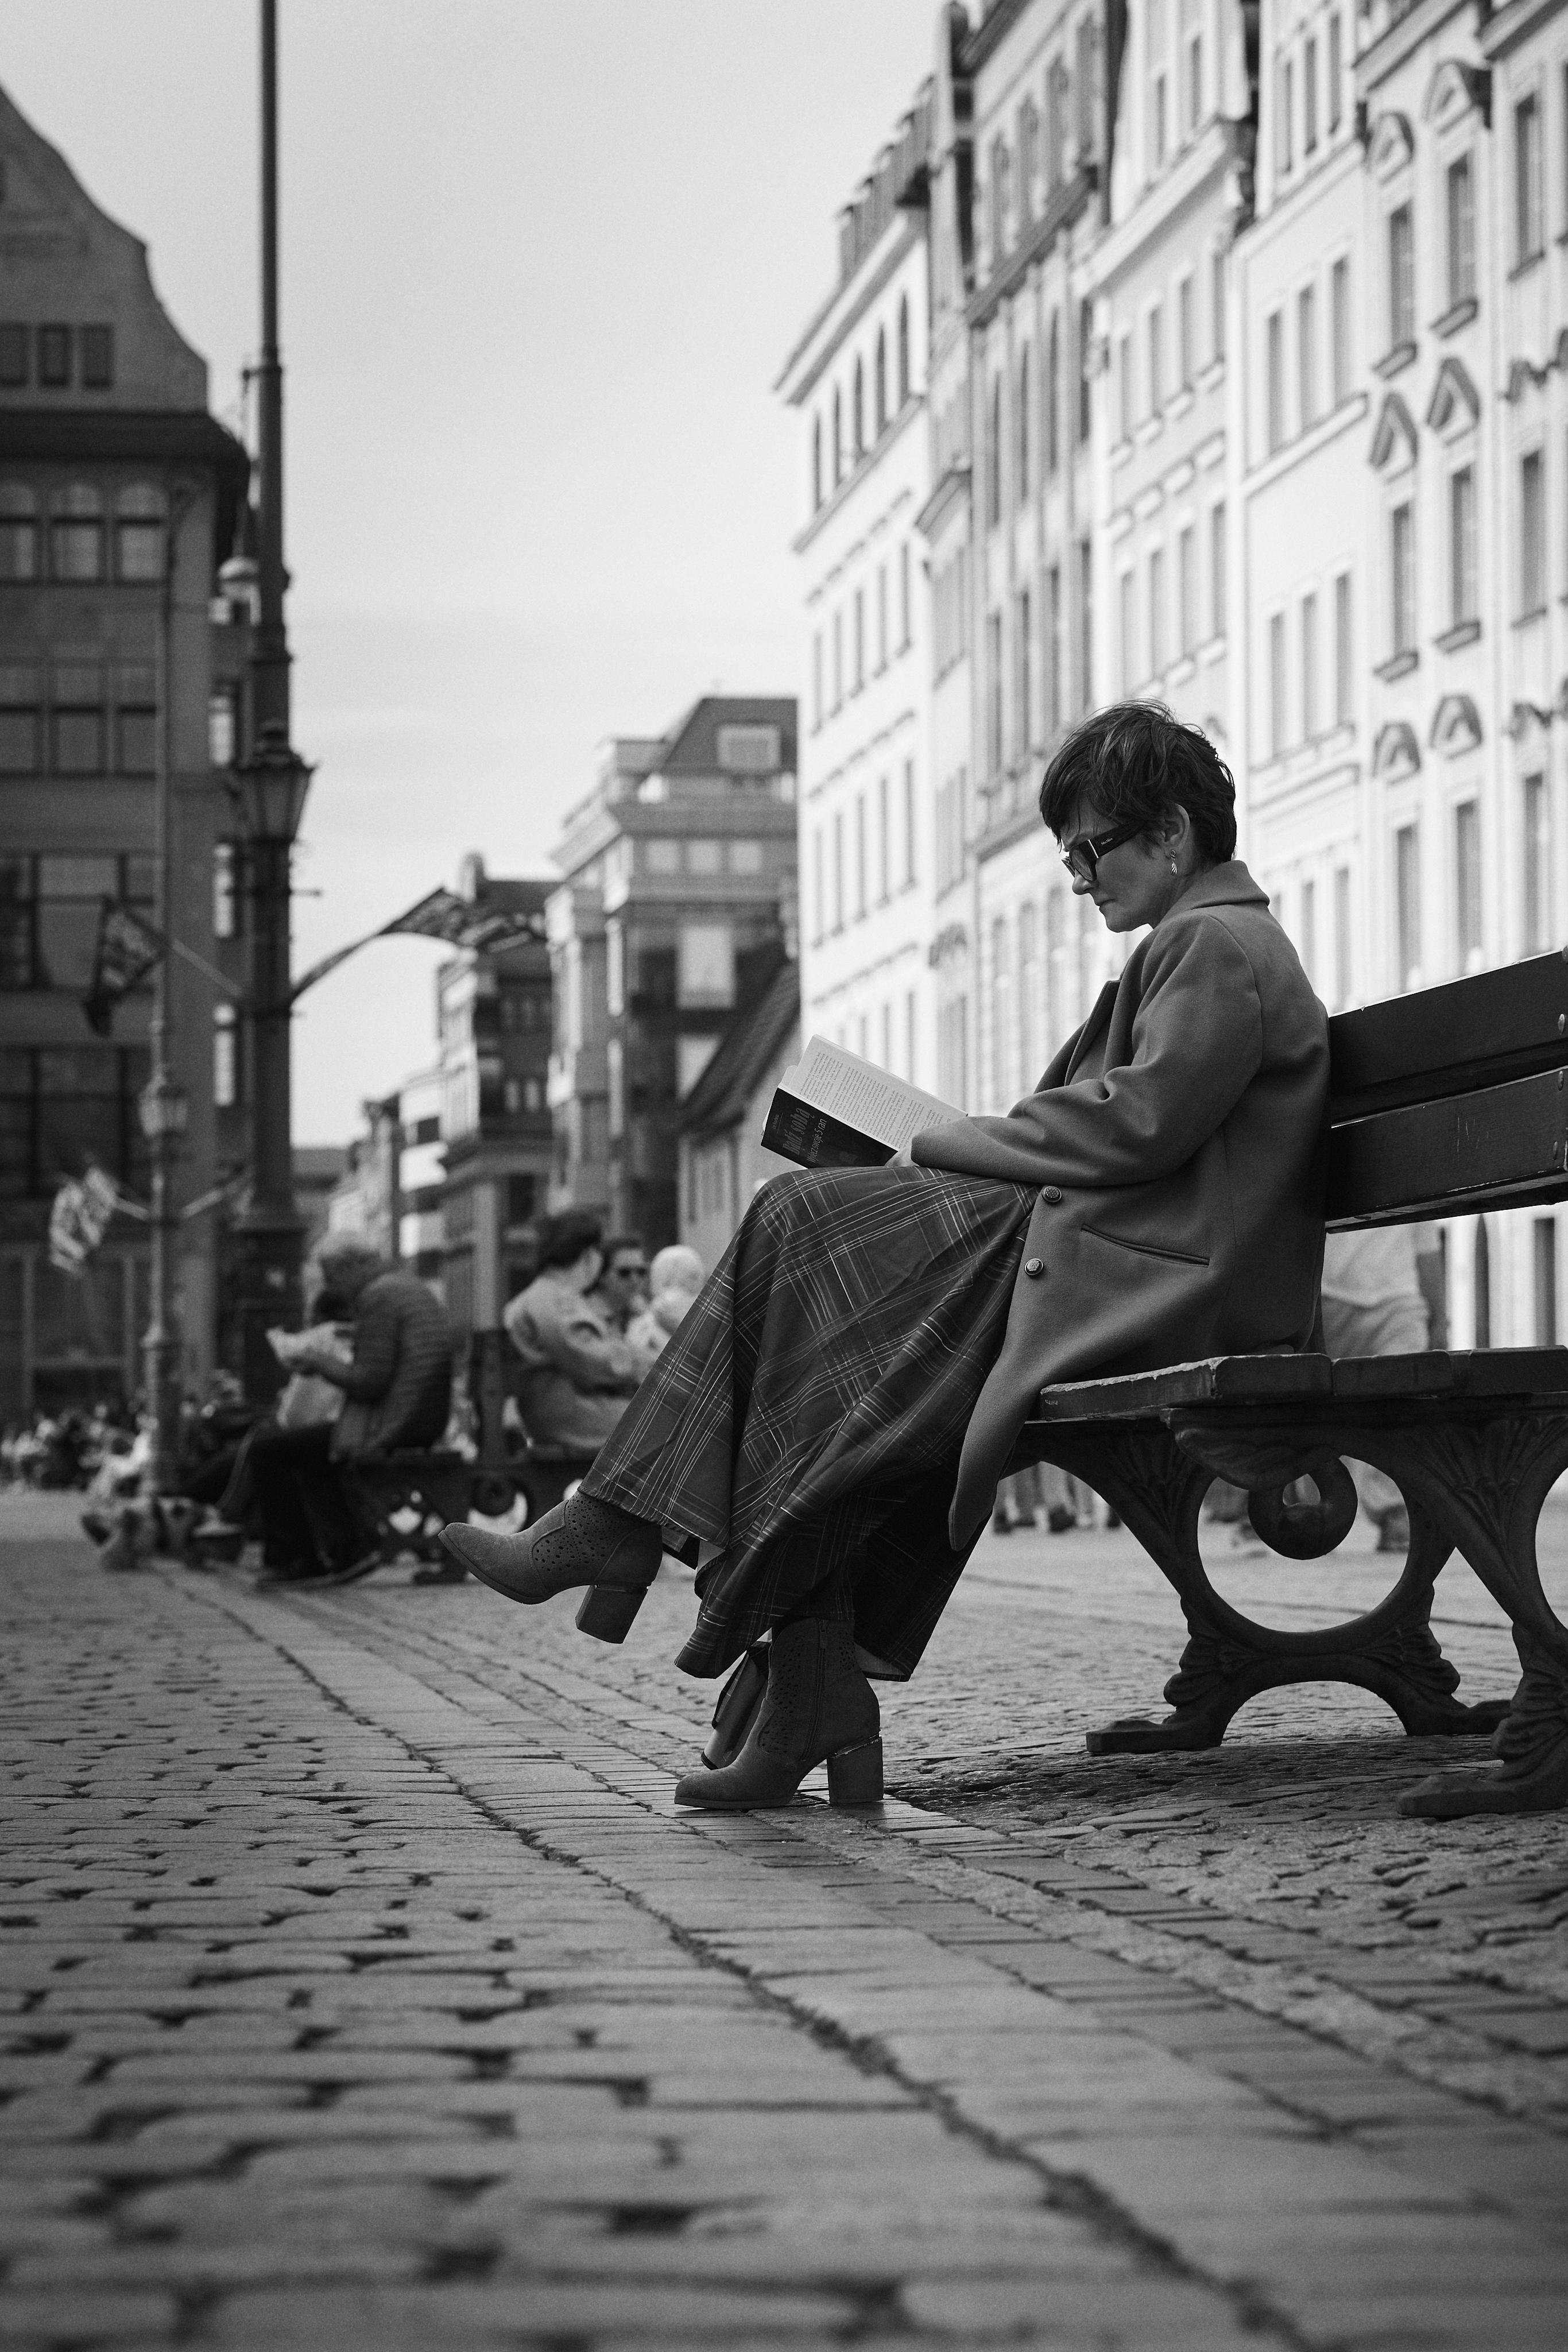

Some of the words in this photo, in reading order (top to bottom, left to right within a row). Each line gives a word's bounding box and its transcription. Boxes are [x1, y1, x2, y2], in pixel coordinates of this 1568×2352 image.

[790, 1108, 815, 1135] sobą
[812, 1134, 823, 1150] swoje
[818, 1119, 827, 1131] ran
[782, 1128, 806, 1155] Bądź
